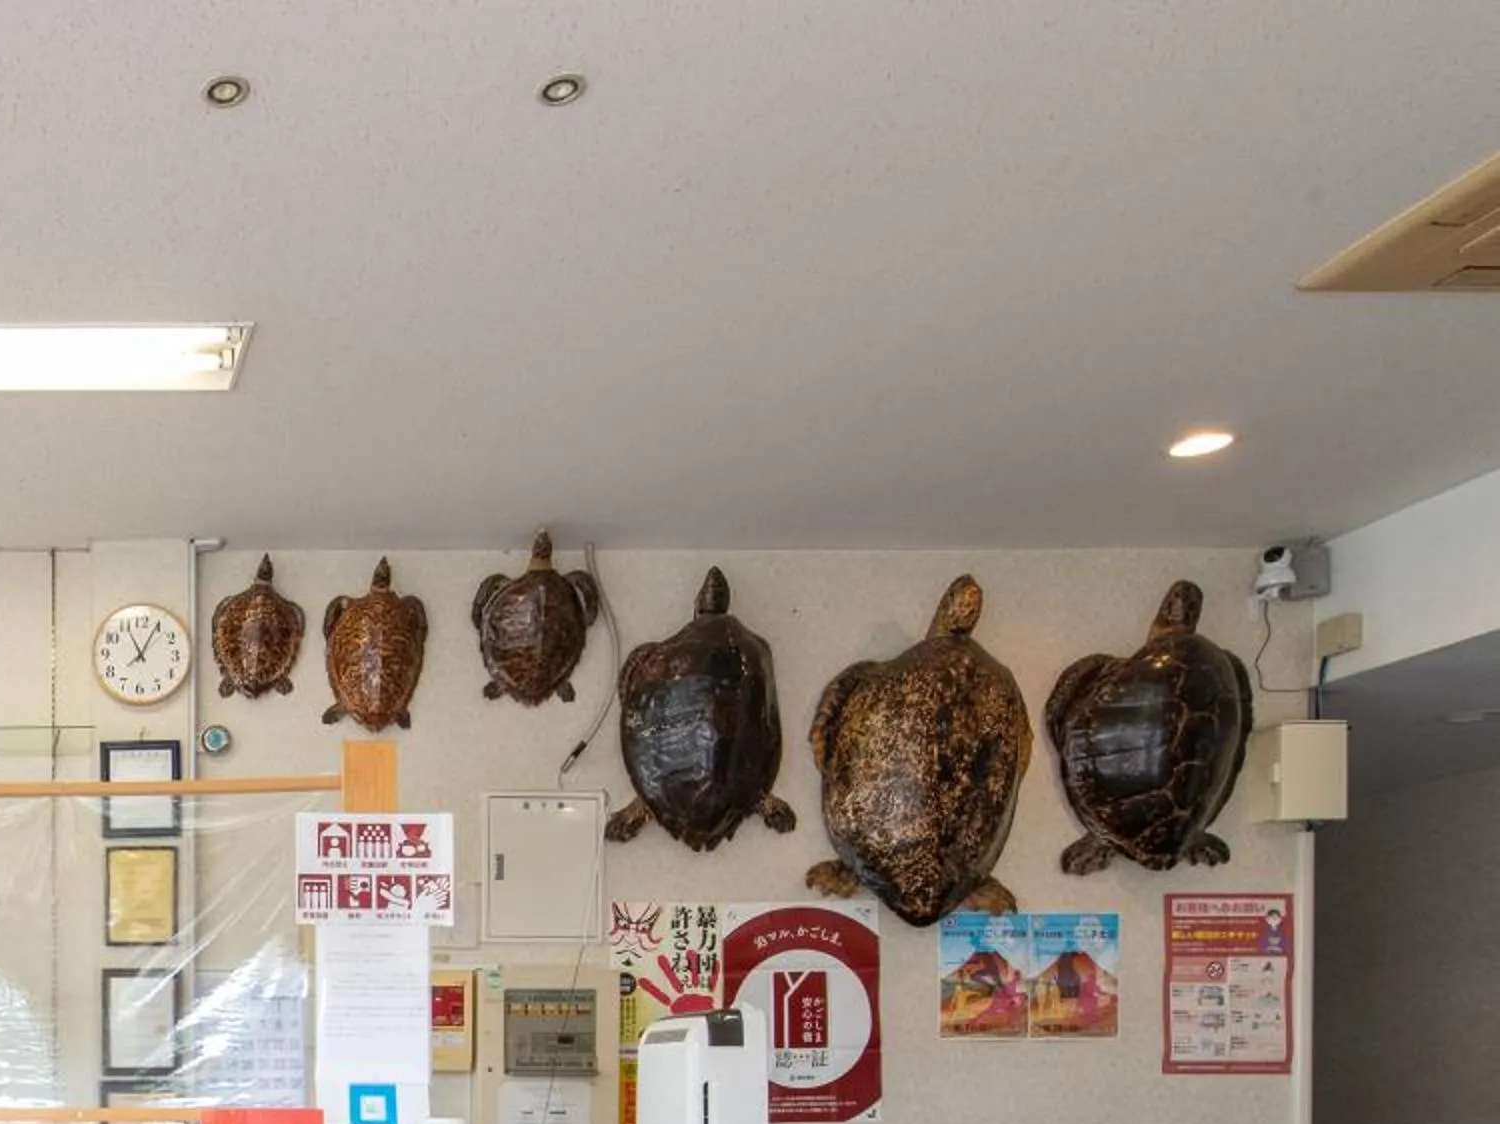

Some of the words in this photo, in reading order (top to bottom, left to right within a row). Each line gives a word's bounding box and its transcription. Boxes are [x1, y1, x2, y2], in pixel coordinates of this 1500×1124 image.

[135, 616, 149, 628] 12
[106, 632, 119, 644] 10
[166, 632, 176, 645] 2
[101, 648, 110, 660] 9
[171, 649, 180, 662] 3
[106, 665, 115, 678] 8
[120, 677, 128, 691] 7
[135, 683, 145, 694] 6
[801, 997, 813, 1042] 安心の宿
[813, 997, 825, 1042] かごしま
